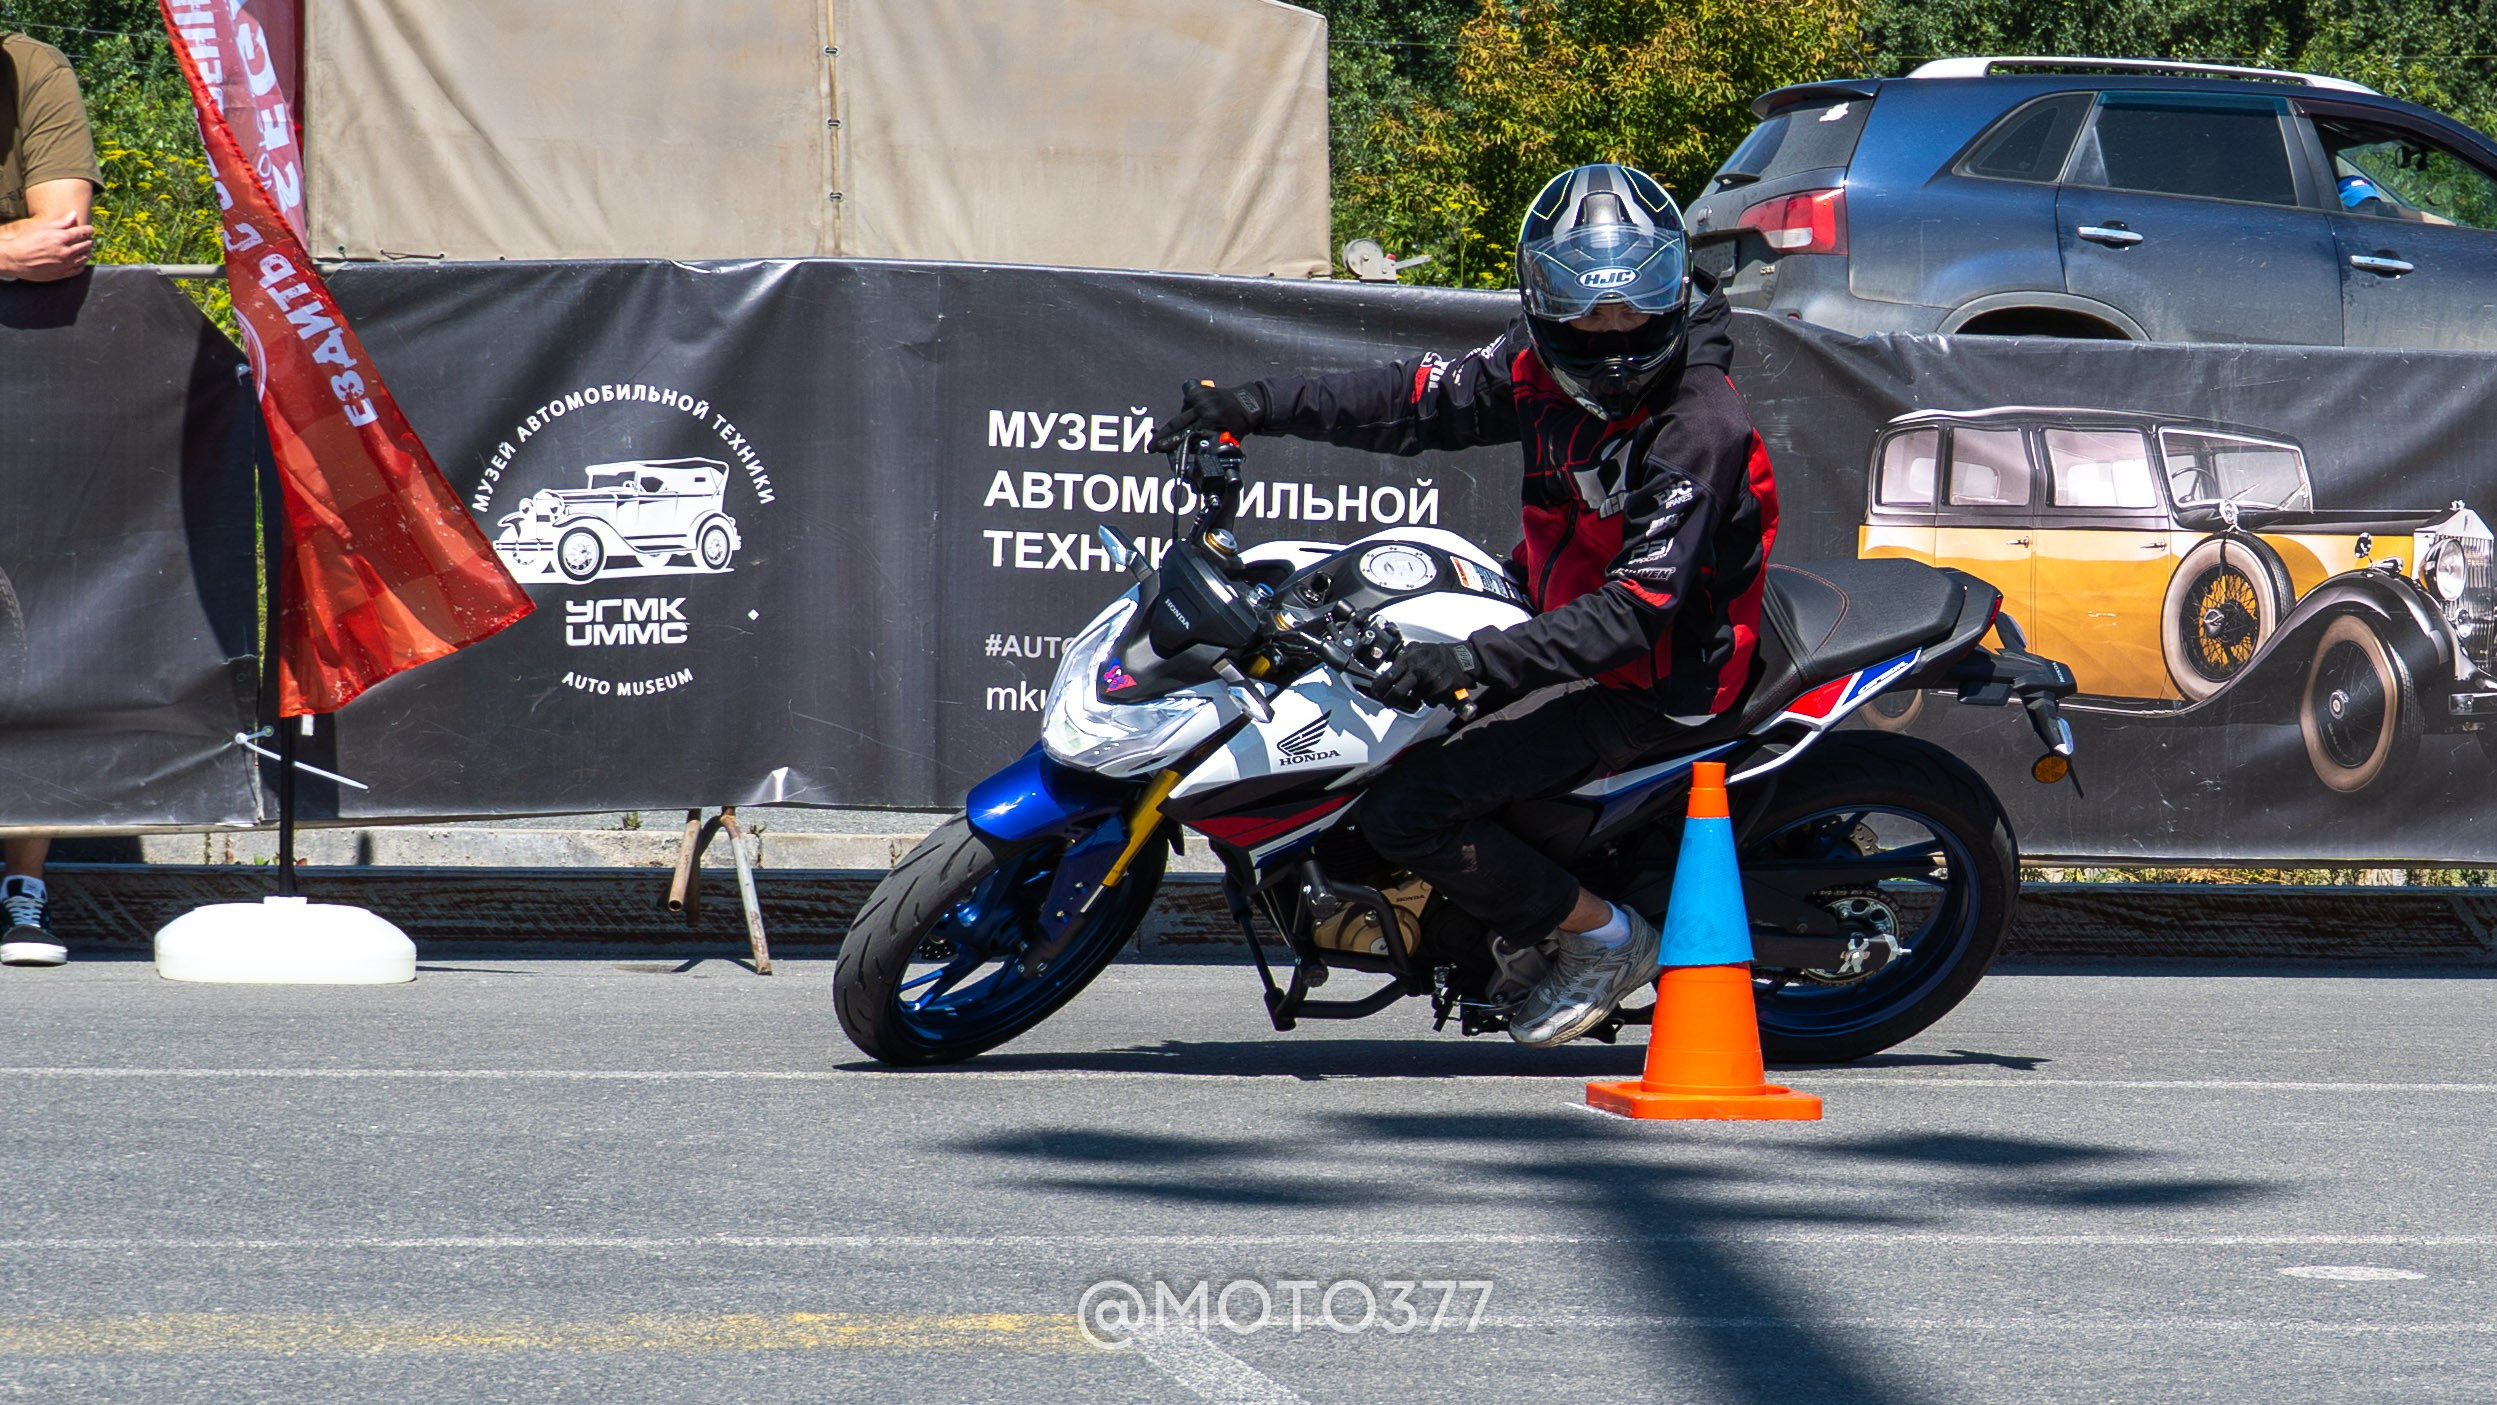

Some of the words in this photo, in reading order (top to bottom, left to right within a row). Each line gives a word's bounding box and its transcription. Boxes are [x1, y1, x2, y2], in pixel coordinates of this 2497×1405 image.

[1583, 269, 1633, 285] HJC
[258, 253, 379, 427] ЕЗДИТЬ
[988, 406, 1154, 454] МУЗЕЙ
[472, 442, 516, 512] МУЗЕЙ
[516, 384, 710, 444] АВТОМОБИЛЬНОЙ
[713, 414, 776, 505] ТЕХНИКИ
[983, 469, 1439, 526] АВТОМОИЛЬНОЙ
[566, 597, 687, 623] УГМК
[1164, 598, 1190, 630] HONDA
[566, 622, 688, 647] UMMC
[562, 671, 610, 695] AUTO
[617, 668, 694, 696] MUSEUM
[1279, 749, 1341, 766] HONDA
